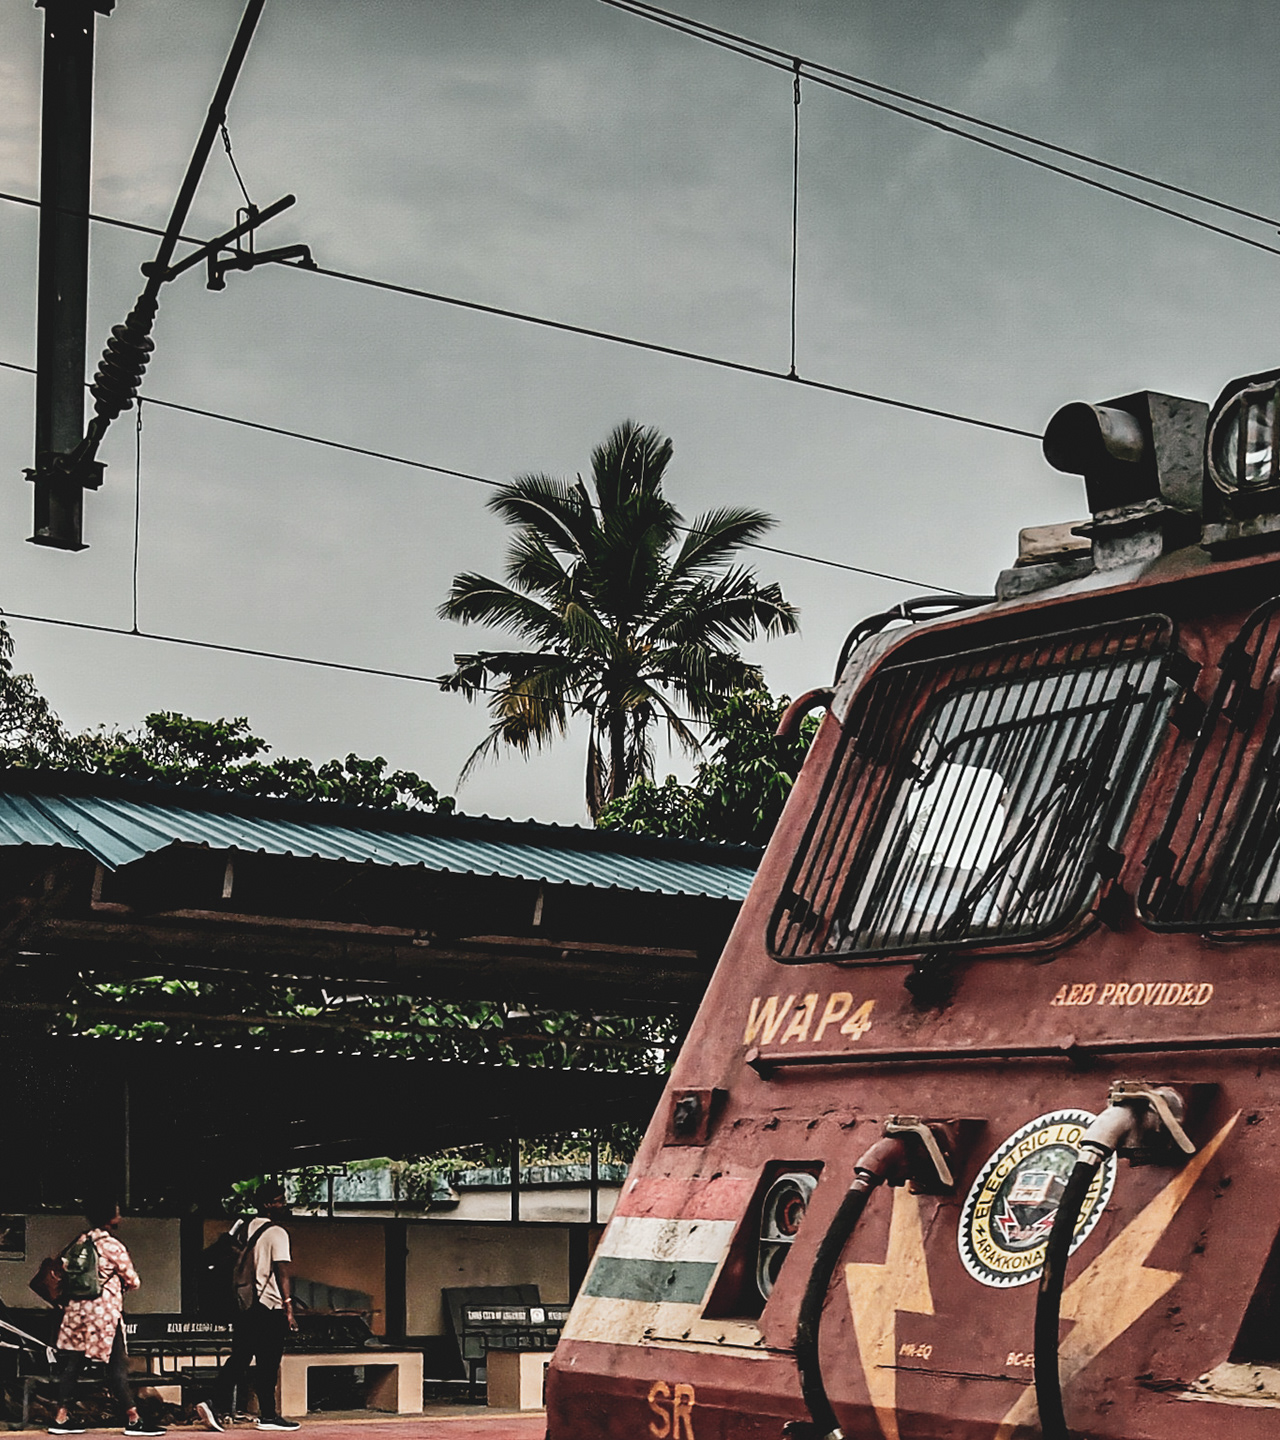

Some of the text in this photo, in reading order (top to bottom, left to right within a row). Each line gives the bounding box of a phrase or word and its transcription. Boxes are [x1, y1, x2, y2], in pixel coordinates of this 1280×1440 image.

[1097, 983, 1214, 1007] PROVIDED
[743, 990, 876, 1047] WAP4
[975, 1130, 1049, 1220] ELECTRIC
[977, 1238, 1044, 1269] ARAKKONA
